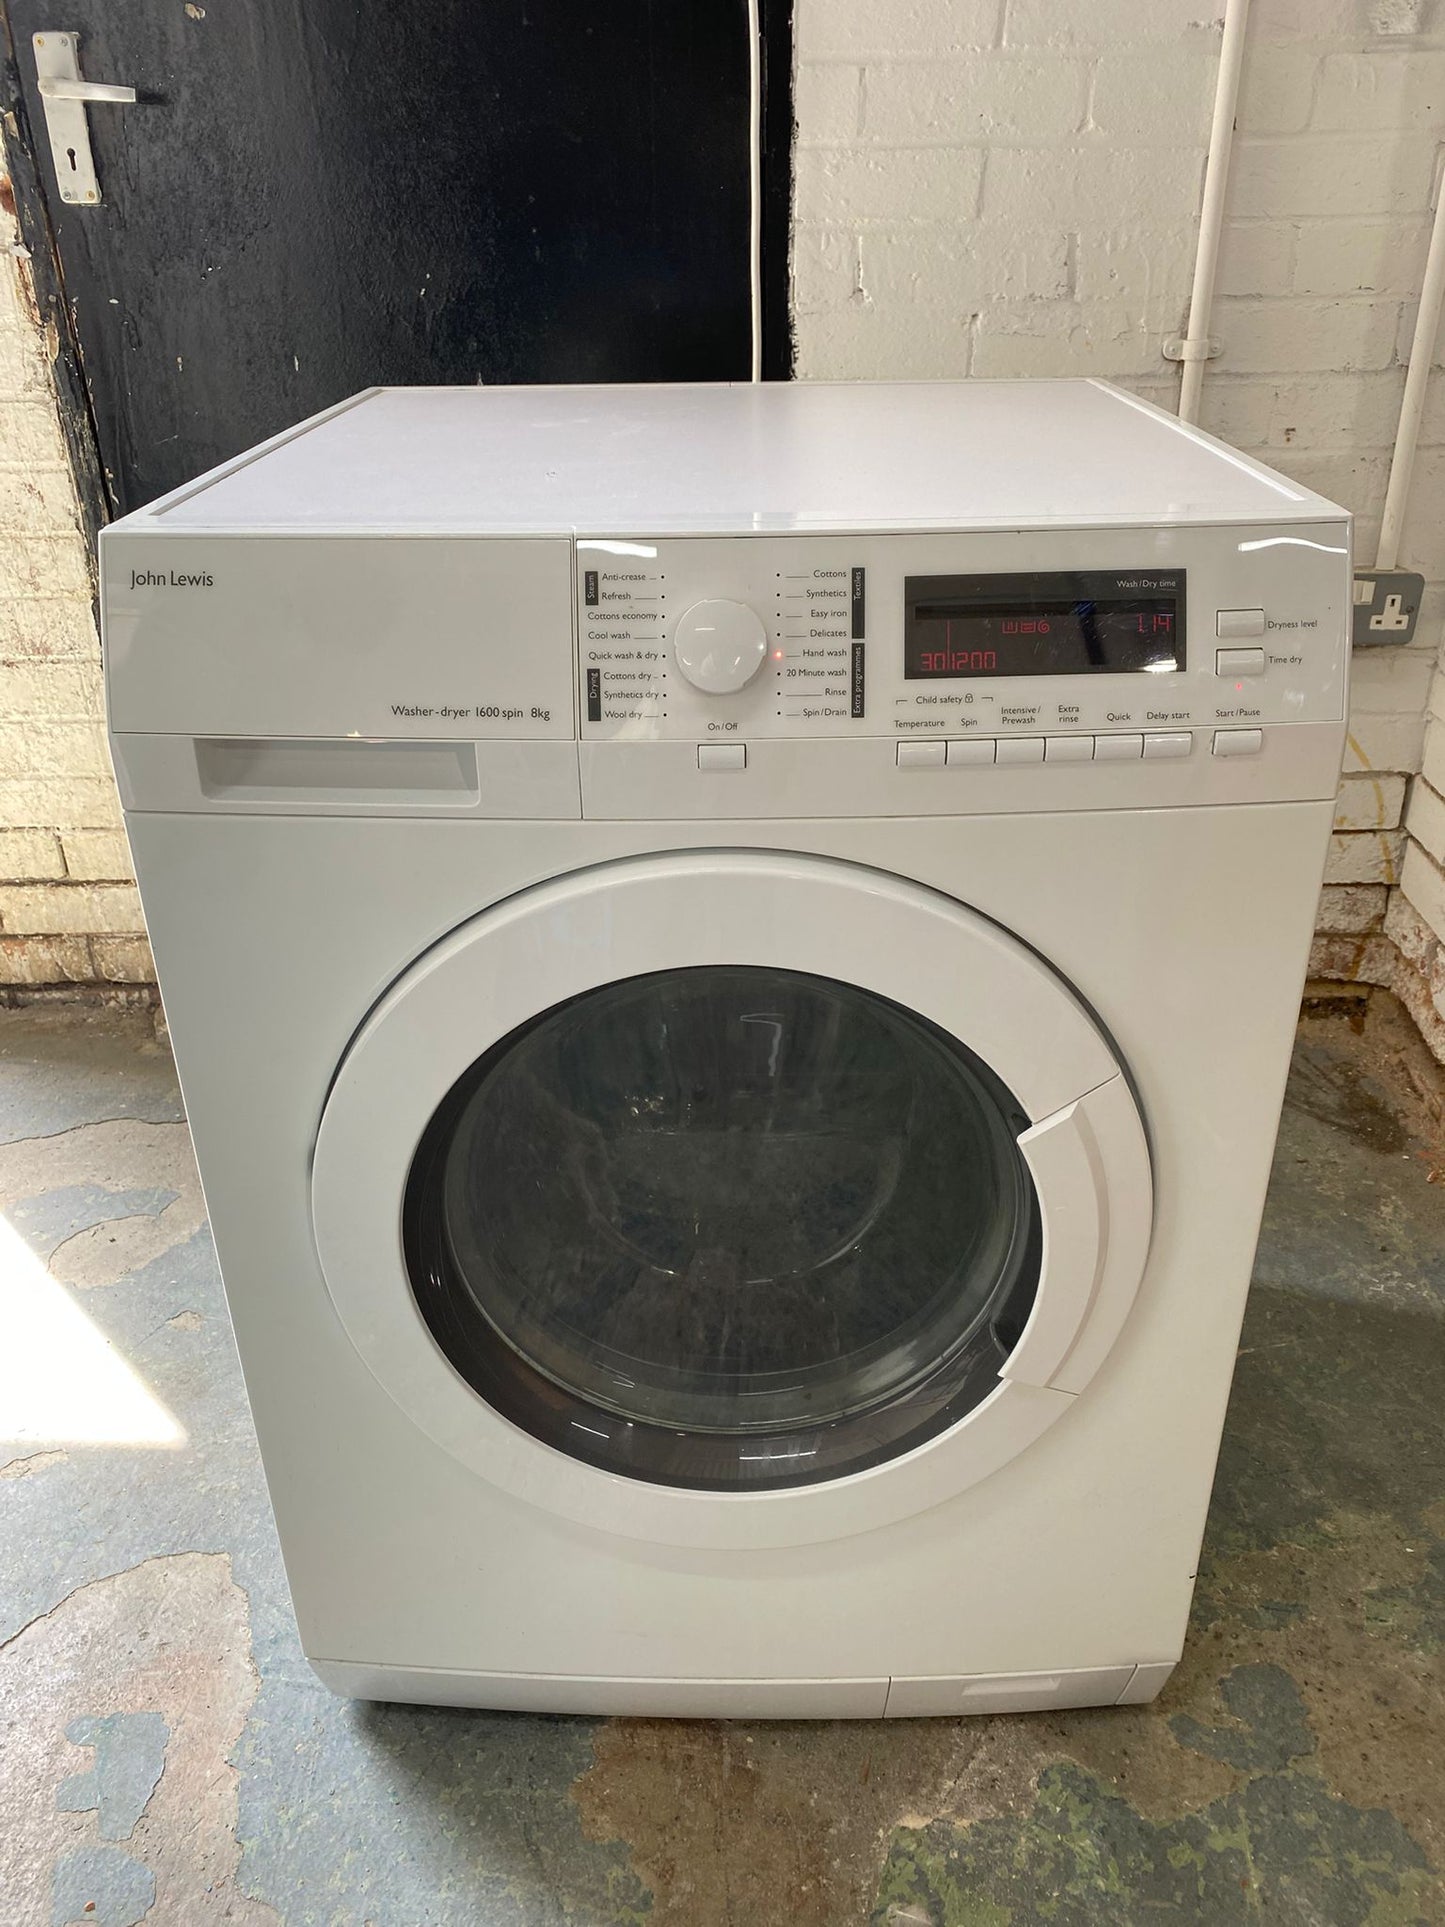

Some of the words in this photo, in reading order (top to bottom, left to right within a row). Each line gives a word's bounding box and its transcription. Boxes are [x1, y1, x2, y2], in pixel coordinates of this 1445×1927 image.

[602, 573, 646, 581] Anti-crease
[813, 569, 847, 578] Cottons
[131, 570, 166, 590] John
[170, 571, 214, 587] Lewis
[1159, 579, 1176, 587] time
[854, 571, 862, 600] Textiles
[602, 592, 631, 600] Refresh
[806, 588, 847, 599] Synthetics
[587, 612, 620, 620] Cottons
[622, 612, 657, 621] economy
[810, 609, 828, 618] Easy
[830, 609, 847, 618] iron
[1267, 620, 1298, 630] Dryness
[1300, 619, 1318, 628] level
[588, 631, 607, 640] Cool
[610, 631, 630, 640] wash
[810, 629, 847, 637] Delicates
[588, 651, 614, 660] Quick
[616, 651, 634, 660] wash
[644, 651, 658, 661] dry
[802, 649, 823, 657] Hand
[826, 649, 847, 657] wash
[1268, 655, 1287, 664] Time
[1290, 655, 1303, 665] dry
[786, 669, 797, 677] 20
[799, 668, 826, 677] Minute
[827, 669, 847, 677] wash
[853, 647, 862, 691] programmes
[603, 672, 636, 680] Cottons
[638, 672, 651, 681] dry
[590, 672, 598, 699] Drying
[604, 691, 644, 700] Synthetics
[646, 691, 659, 701] dry
[825, 688, 847, 696] Rinse
[916, 696, 938, 704] Child
[940, 695, 962, 705] safety
[475, 706, 500, 718] 1600
[502, 708, 523, 720] spin
[530, 708, 550, 721] 8kg
[1058, 705, 1080, 713] Extra
[605, 710, 625, 719] Wool
[628, 710, 642, 720] dry
[1059, 715, 1079, 723] rinse
[1107, 712, 1131, 721] Quick
[1147, 711, 1170, 720] Delay
[1172, 710, 1190, 719] start
[894, 718, 945, 729] Temperature
[961, 718, 978, 728] Spin
[1002, 716, 1035, 725] Prewash
